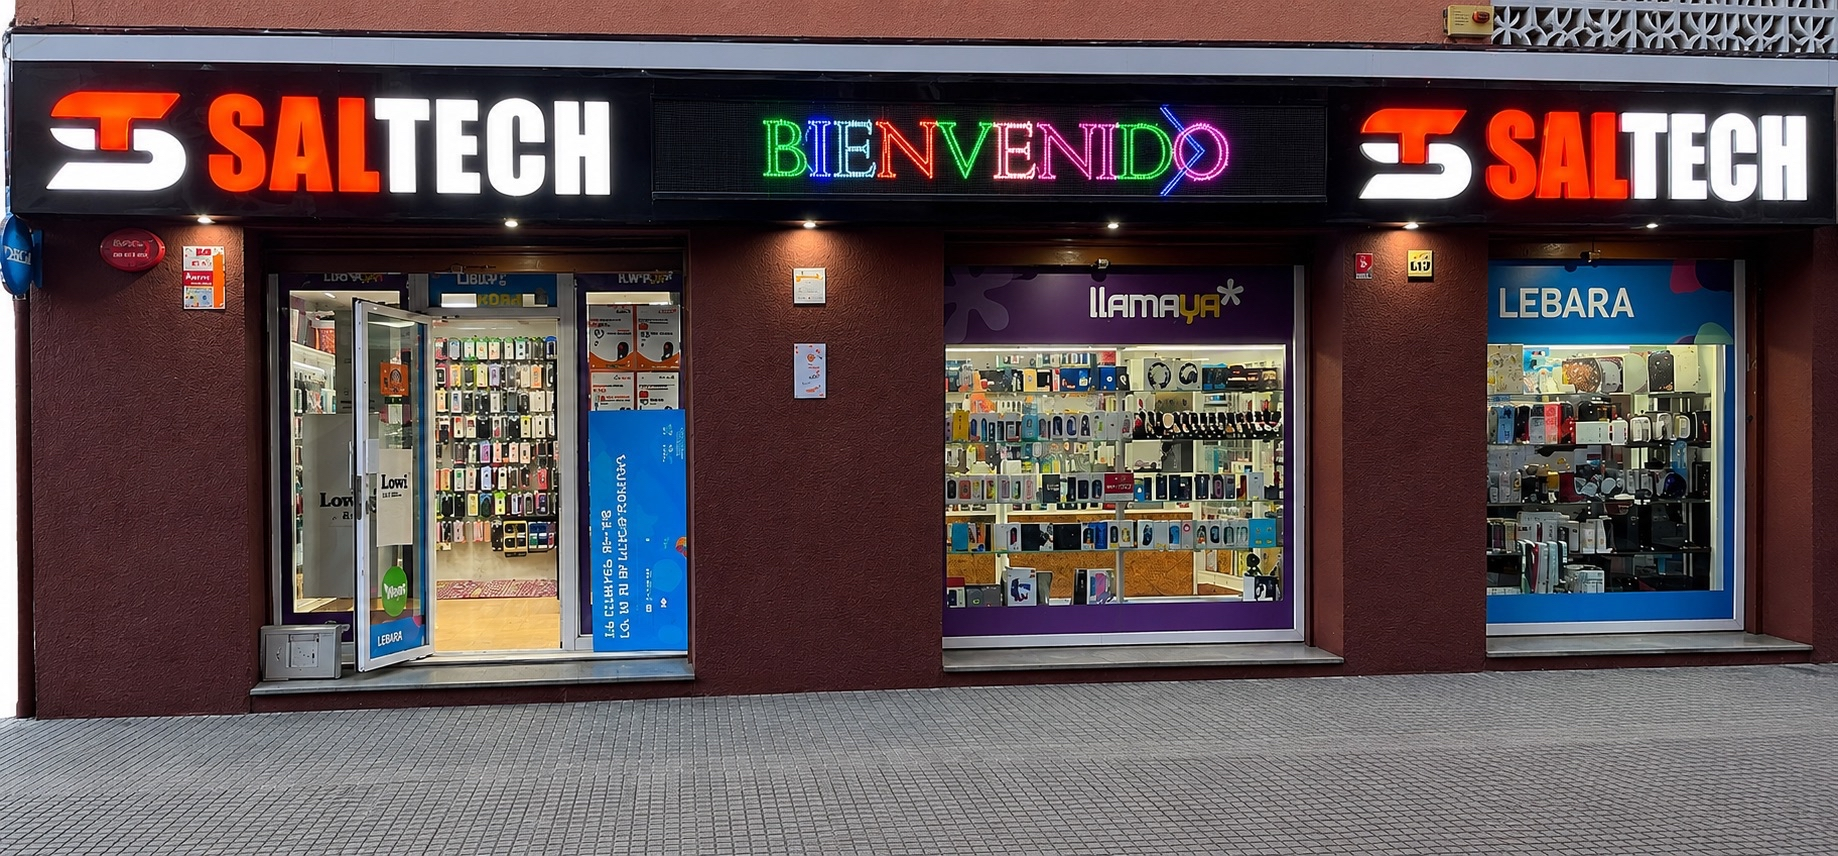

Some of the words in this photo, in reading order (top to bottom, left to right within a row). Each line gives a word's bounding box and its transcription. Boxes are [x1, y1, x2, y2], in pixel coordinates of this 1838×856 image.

[207, 92, 611, 197] SALTECH
[762, 117, 1230, 182] BIENVENIDO
[1485, 108, 1809, 202] SALTECH
[1499, 287, 1634, 319] LEBARA
[381, 474, 408, 490] Lowi
[319, 490, 354, 508] Low
[377, 630, 403, 647] LEBARA
